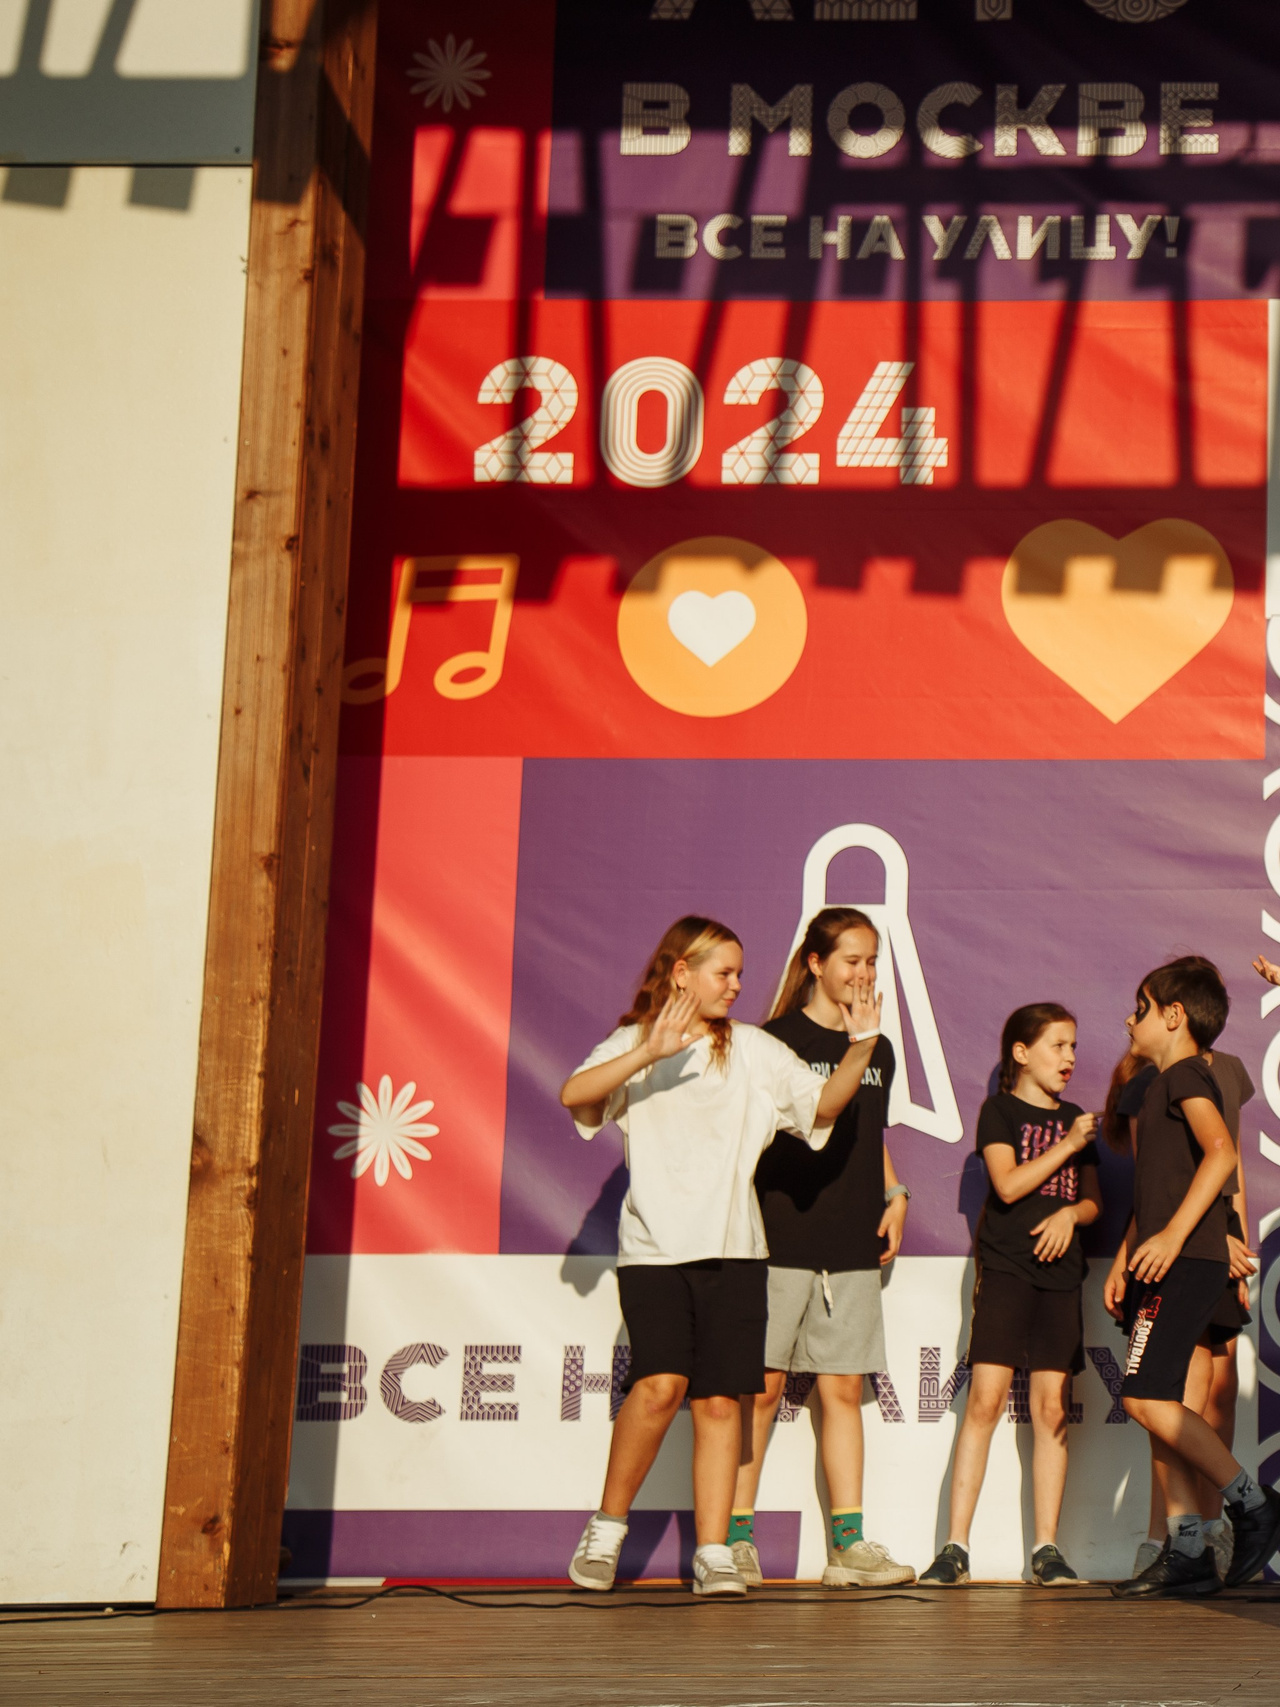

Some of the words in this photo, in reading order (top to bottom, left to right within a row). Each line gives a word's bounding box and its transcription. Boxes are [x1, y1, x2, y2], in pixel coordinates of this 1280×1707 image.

[620, 82, 692, 157] В
[728, 81, 1220, 159] МОСКВЕ
[655, 214, 788, 260] ВСЕ
[809, 215, 906, 260] НА
[922, 213, 1180, 260] УЛИЦУ!
[474, 356, 949, 488] 2024
[295, 1343, 522, 1424] ВСЕ
[1126, 1320, 1154, 1376] FOOTBALL
